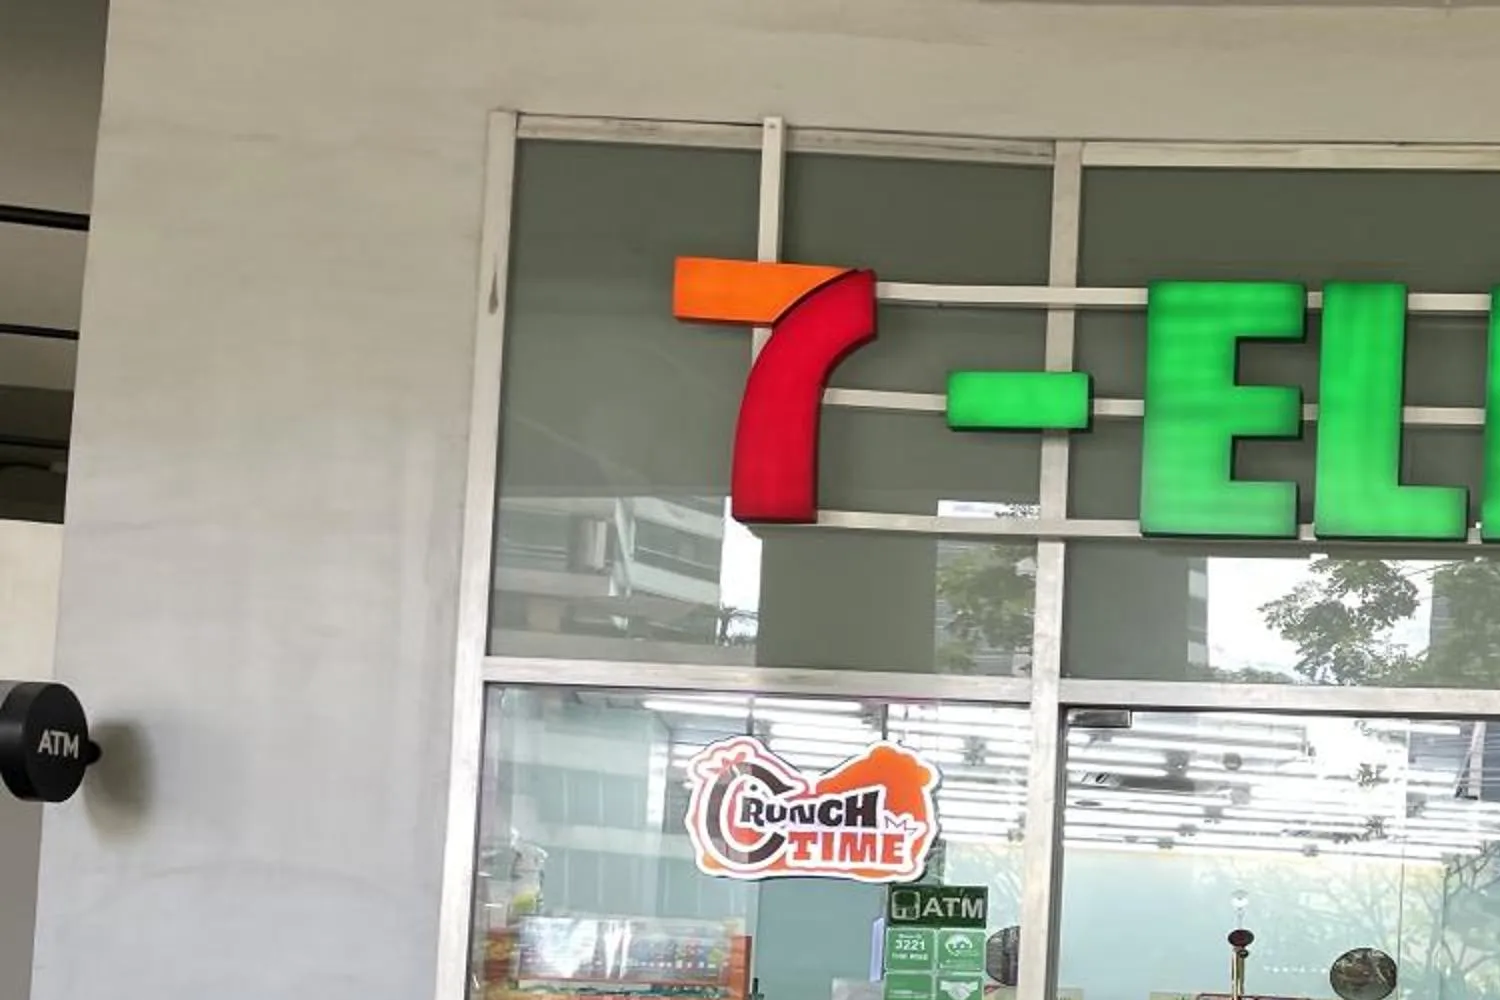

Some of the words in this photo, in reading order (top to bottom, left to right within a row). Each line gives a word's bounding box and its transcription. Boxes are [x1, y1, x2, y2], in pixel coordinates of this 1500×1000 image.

[37, 729, 79, 759] ATM
[706, 761, 880, 865] CRUNCH
[788, 831, 905, 864] TIME
[922, 897, 983, 919] ATM
